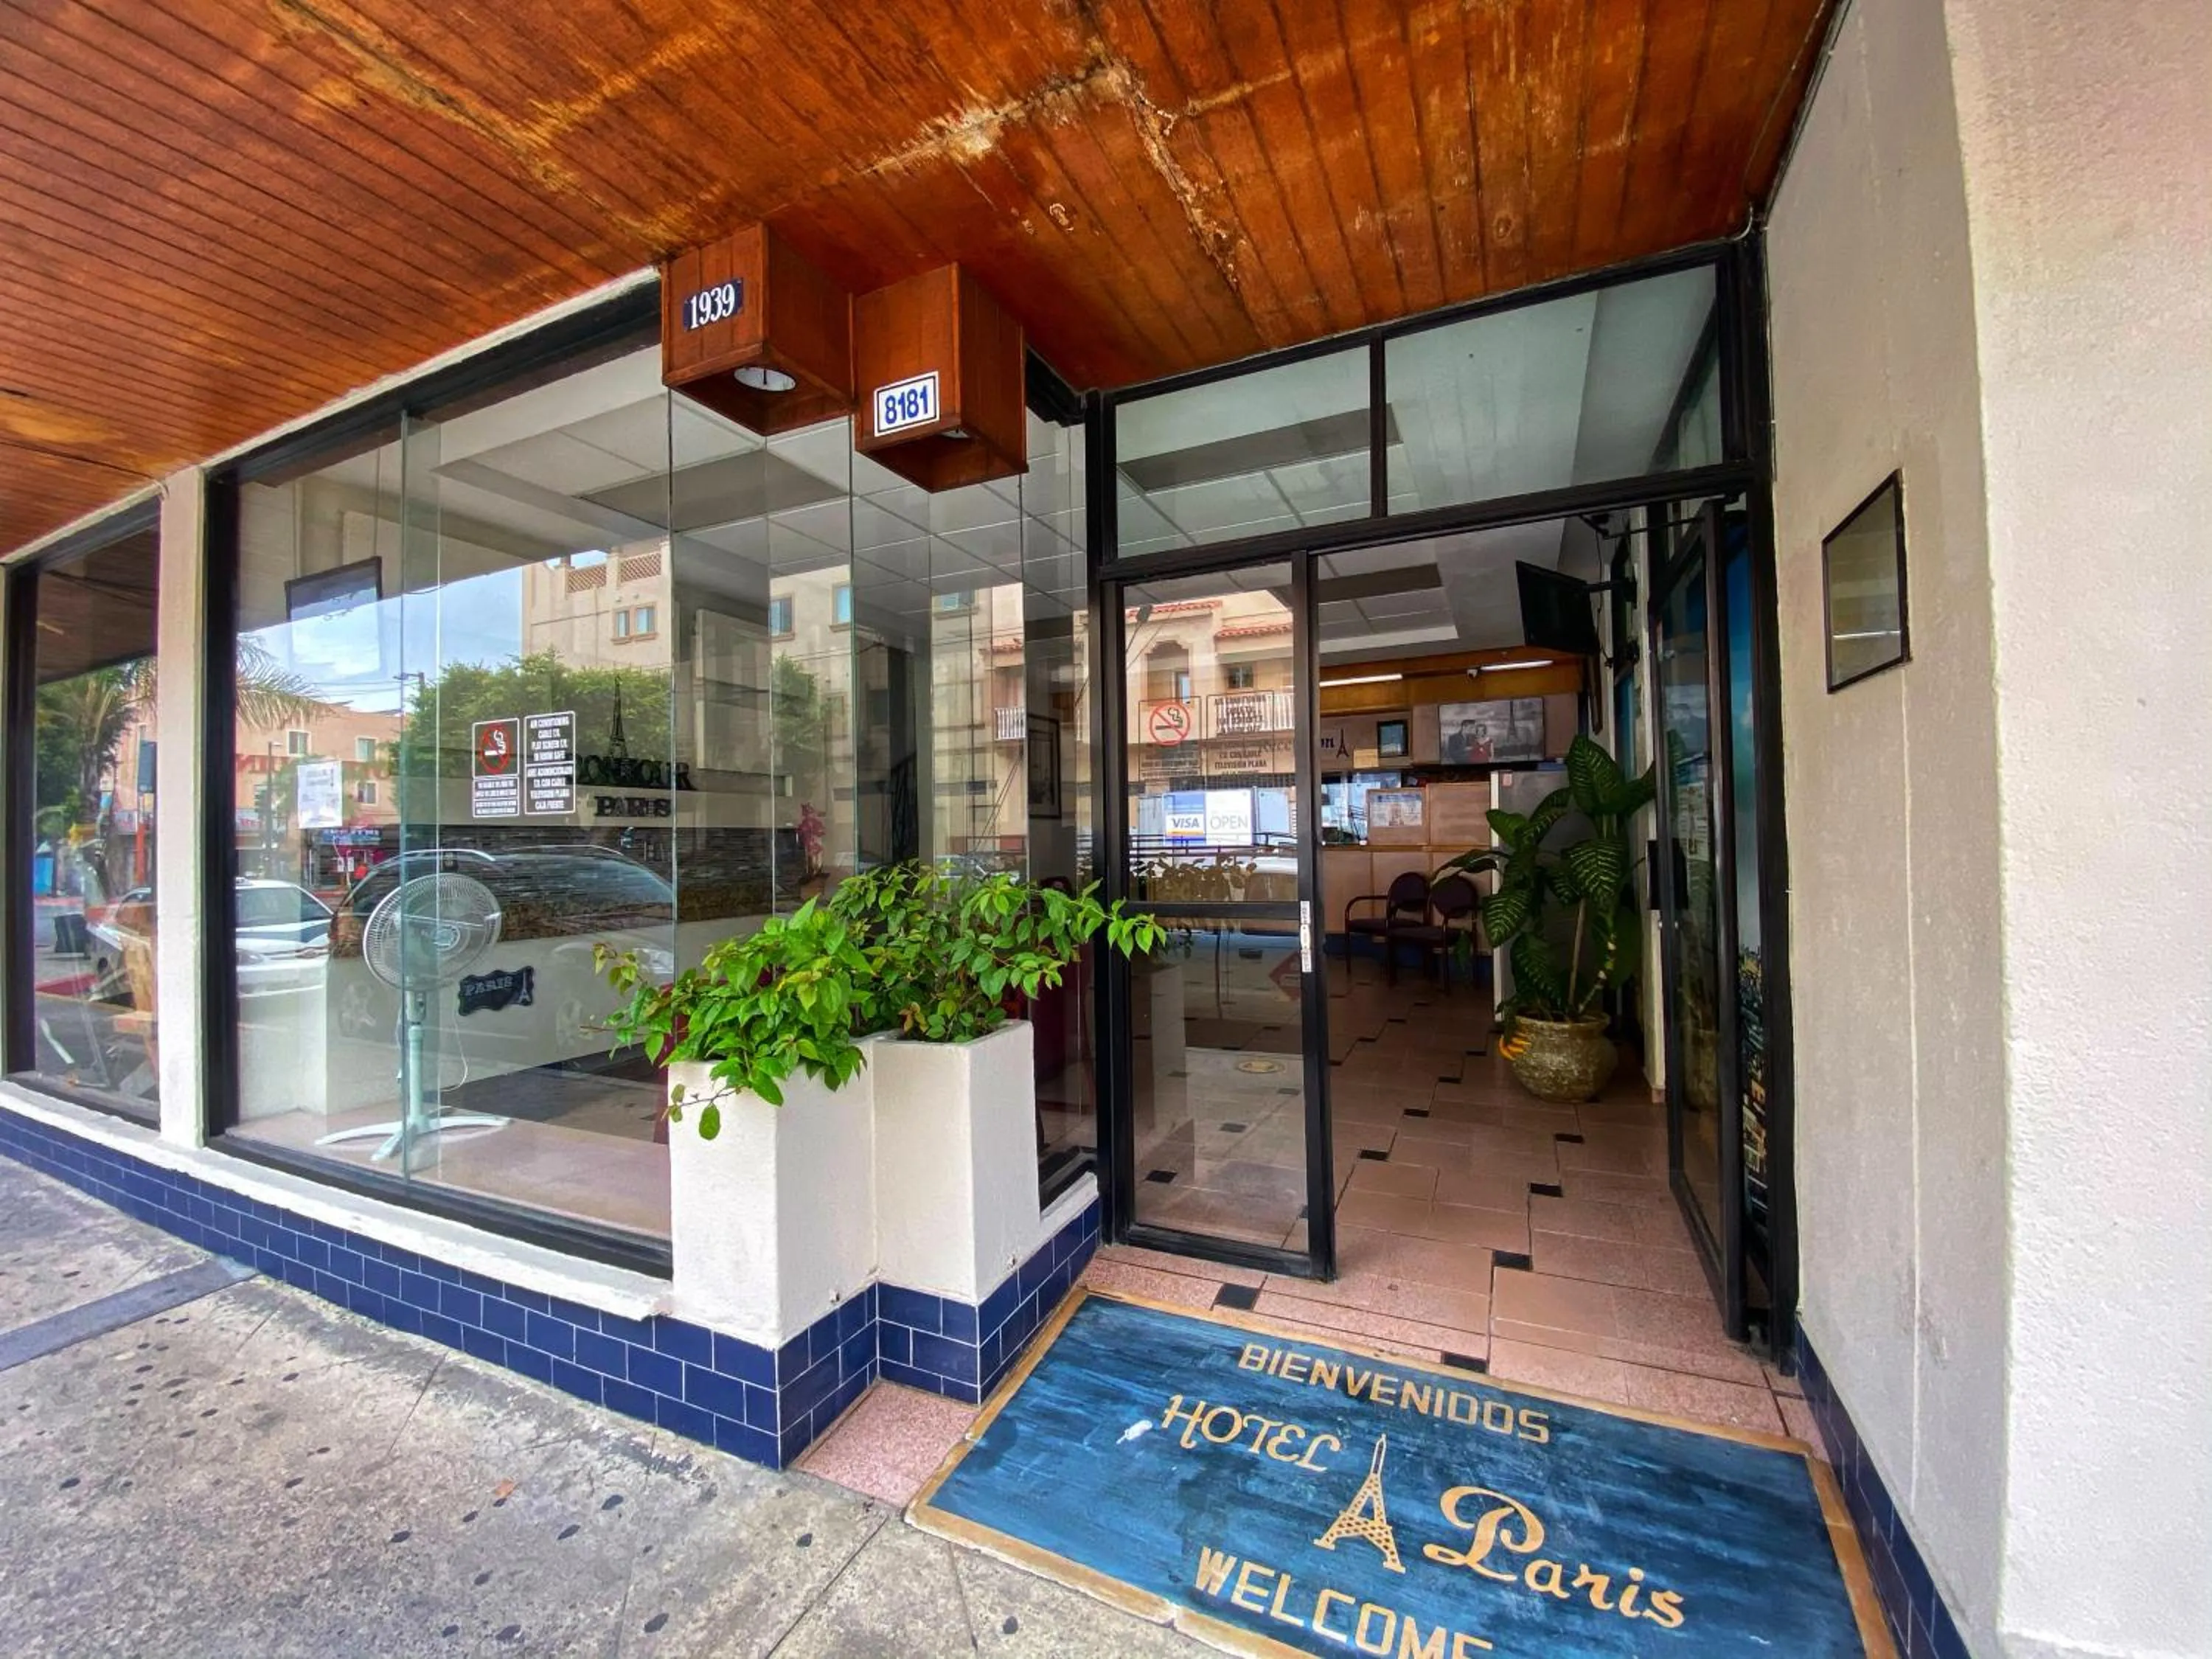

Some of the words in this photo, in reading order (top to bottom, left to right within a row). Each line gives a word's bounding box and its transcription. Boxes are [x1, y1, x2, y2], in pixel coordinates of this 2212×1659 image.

[690, 283, 734, 329] 1939
[885, 386, 928, 424] 8181
[1172, 817, 1200, 828] VISA
[1210, 814, 1248, 830] OPEN
[1238, 1343, 1551, 1443] BIENVENIDOS
[1161, 1394, 1341, 1472] HOTEL
[1423, 1486, 1685, 1628] Paris
